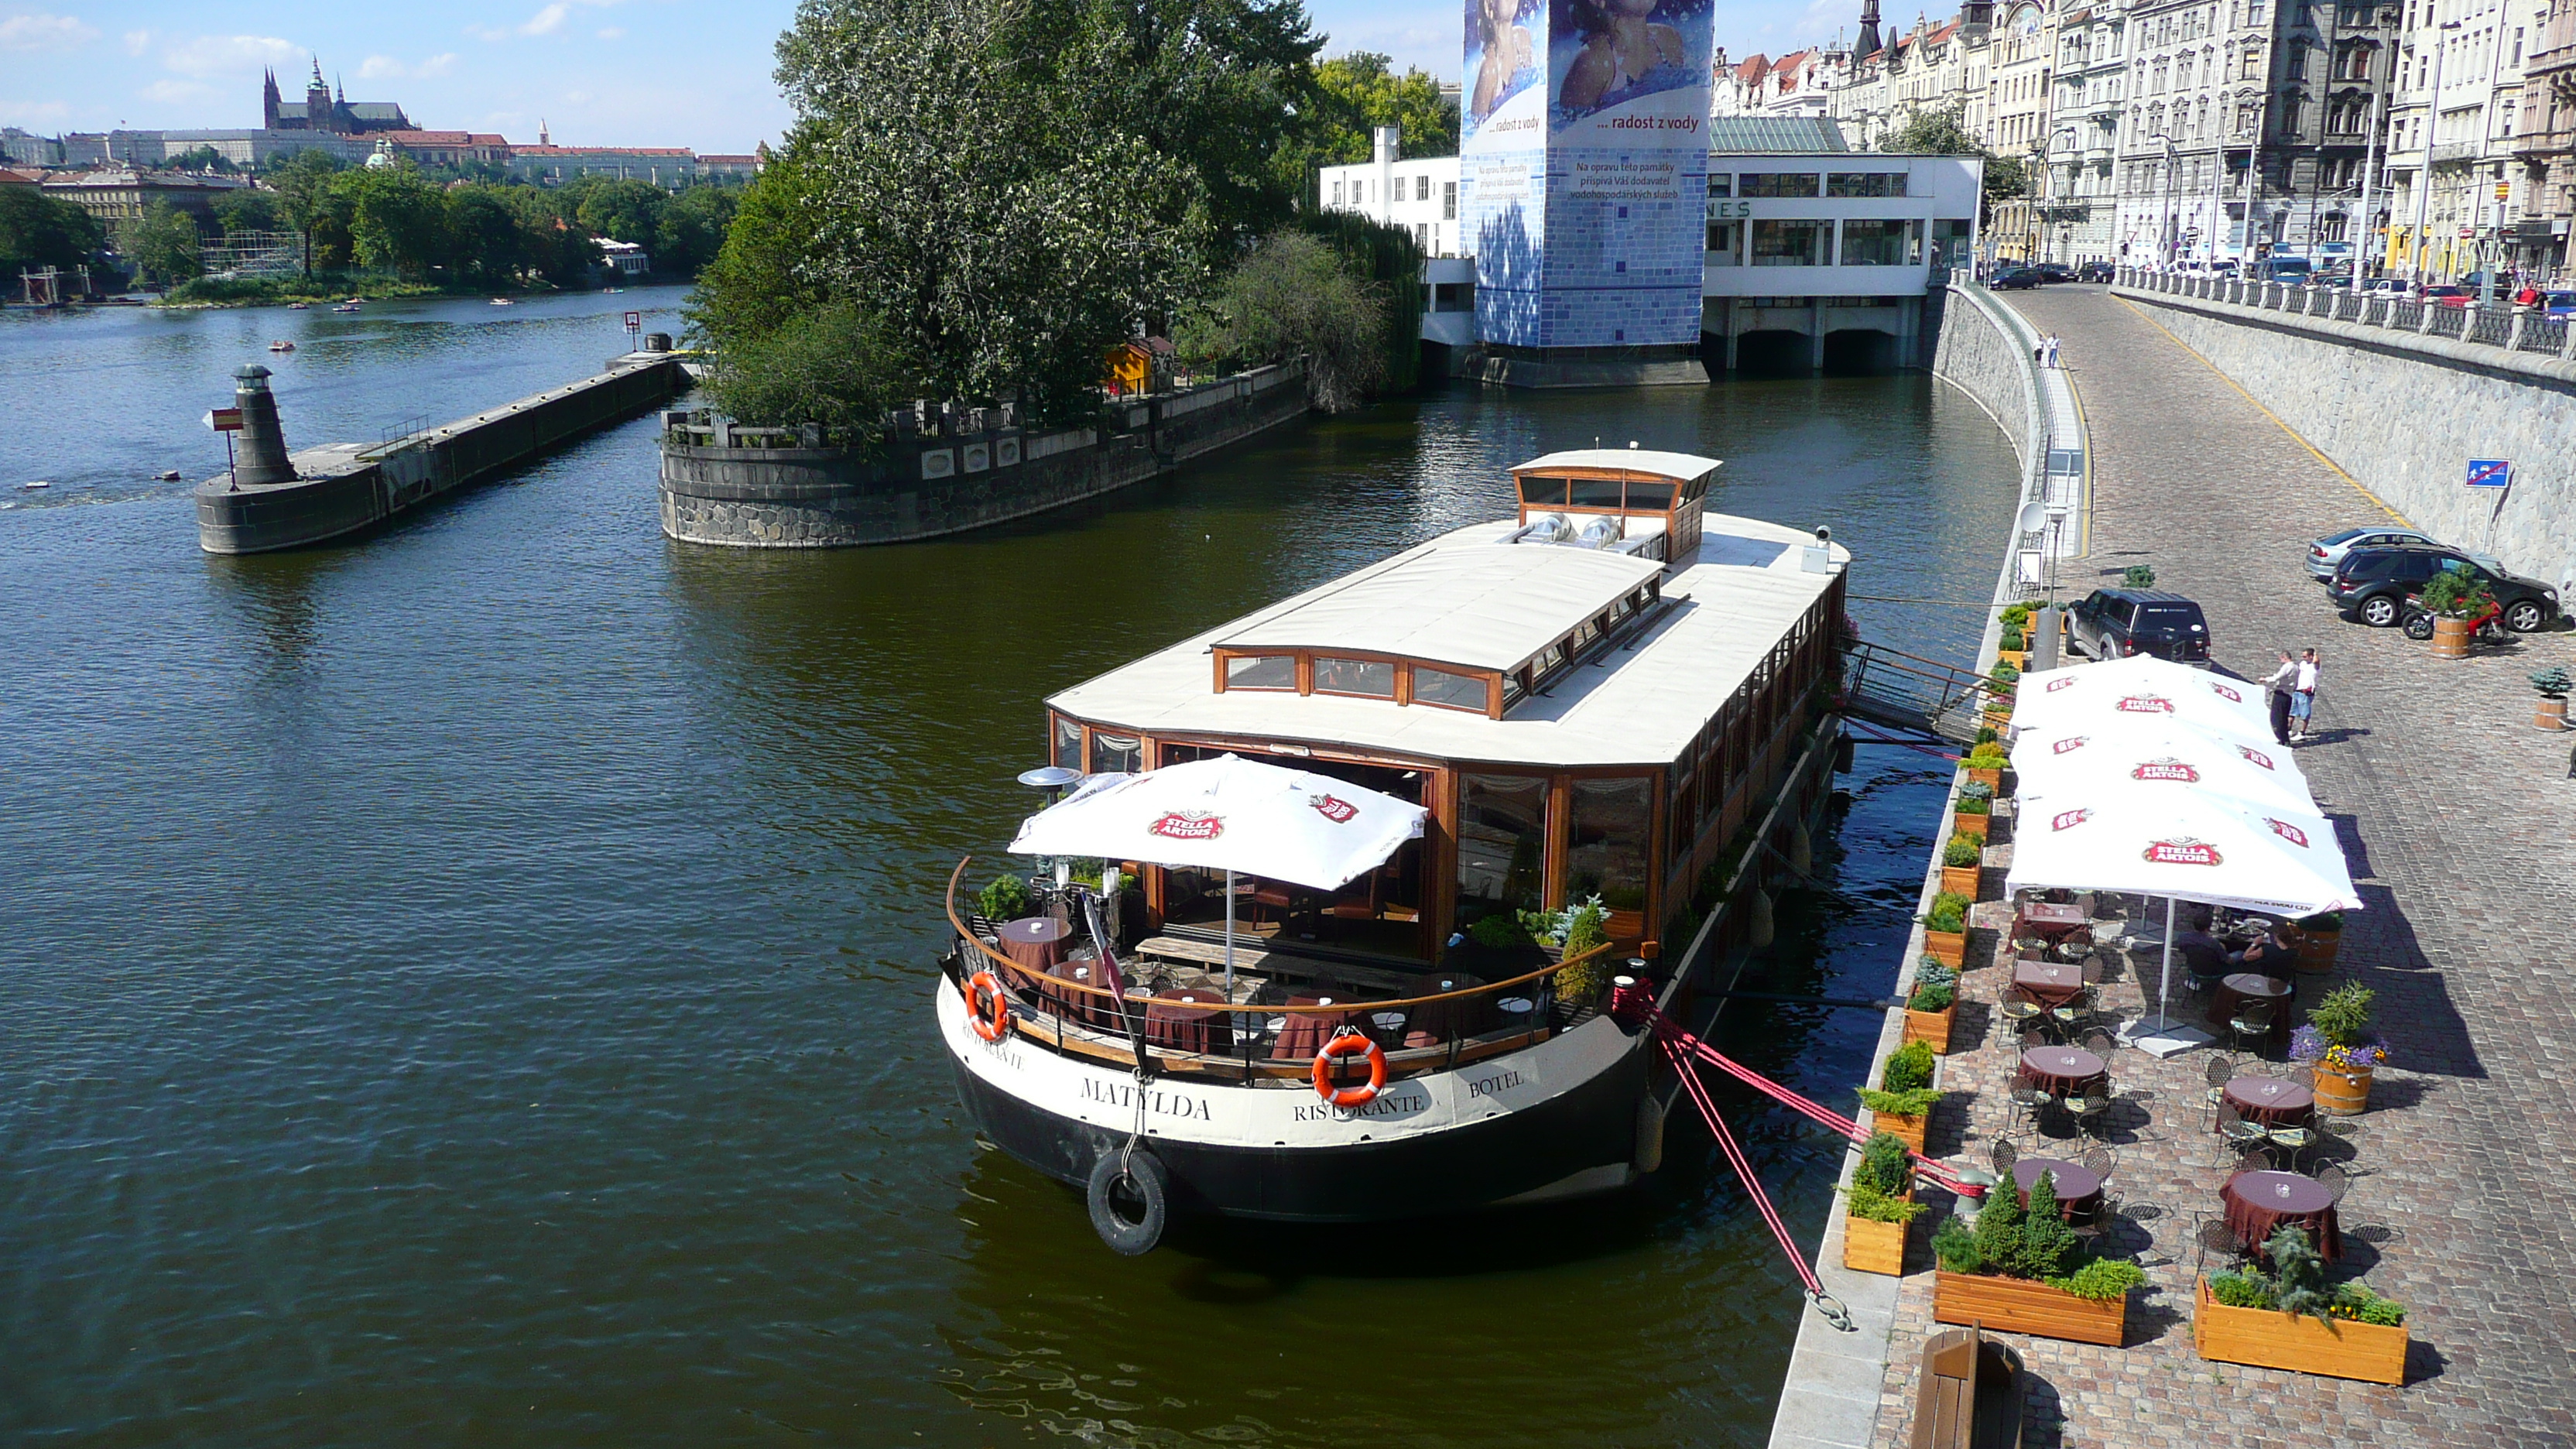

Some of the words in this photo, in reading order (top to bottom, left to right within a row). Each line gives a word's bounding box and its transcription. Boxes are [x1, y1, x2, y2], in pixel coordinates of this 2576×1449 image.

[1523, 115, 1540, 132] vody
[1612, 115, 1654, 128] radost
[1658, 118, 1664, 128] z
[1667, 115, 1699, 133] vody
[1576, 163, 1588, 171] Na
[1591, 164, 1619, 173] opravu
[1614, 176, 1629, 185] Váš
[1630, 176, 1670, 186] dodavatel
[1653, 190, 1678, 199] služeb
[1166, 817, 1213, 829] STELLA
[1160, 825, 1211, 836] ARTOIS
[2156, 846, 2210, 855] STELLA
[2156, 853, 2210, 862] ARTOIS
[1468, 1070, 1525, 1099] BOTEL
[1080, 1077, 1212, 1122] MATYLDA
